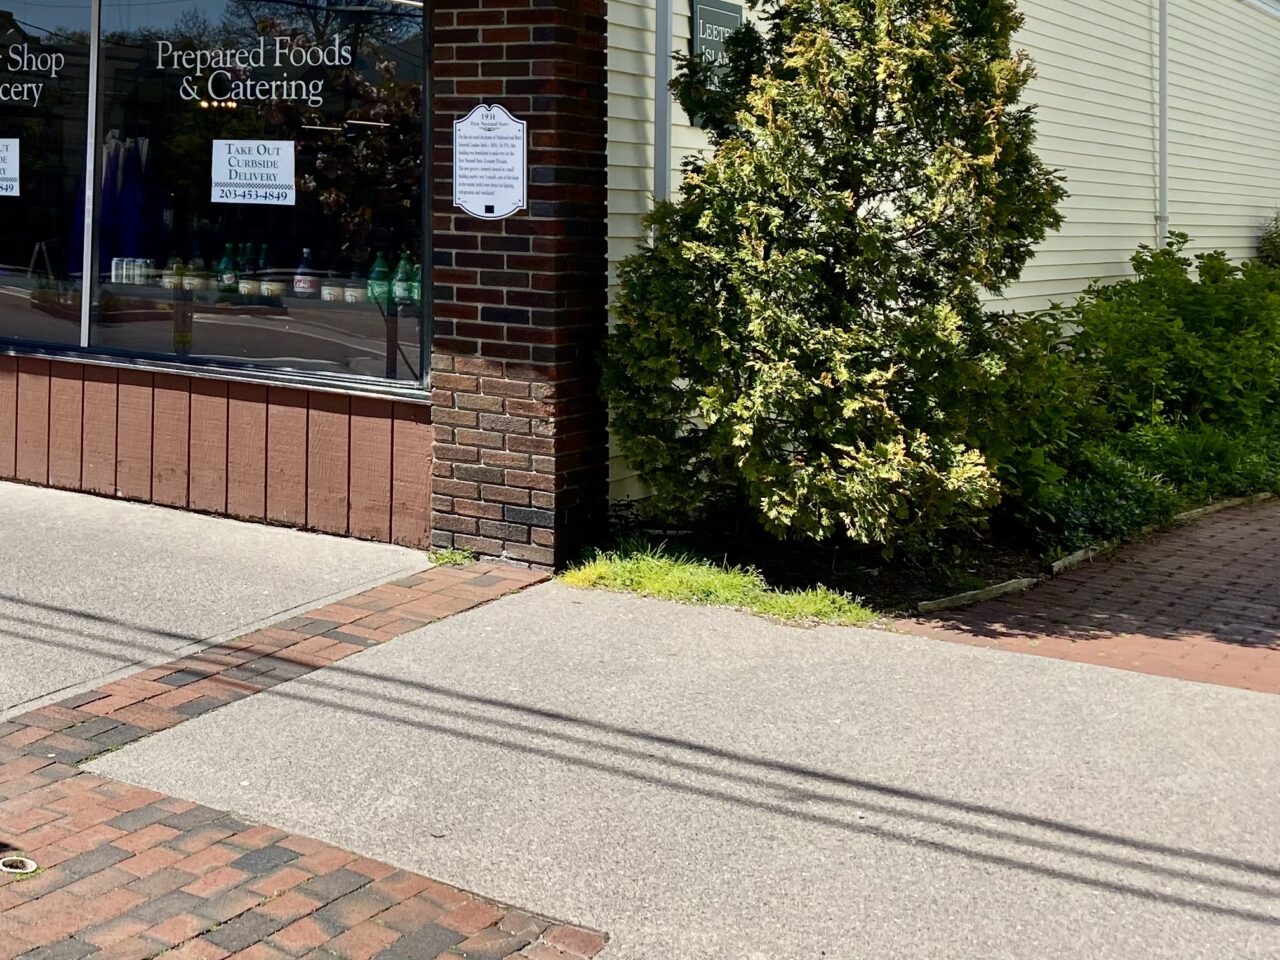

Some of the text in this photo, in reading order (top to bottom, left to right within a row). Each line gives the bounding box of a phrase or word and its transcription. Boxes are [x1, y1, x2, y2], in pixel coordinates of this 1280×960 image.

[7, 42, 65, 78] Shop
[155, 33, 352, 76] Prepared Foods
[179, 69, 324, 107] & Catering
[219, 189, 288, 201] 203-453-4849
